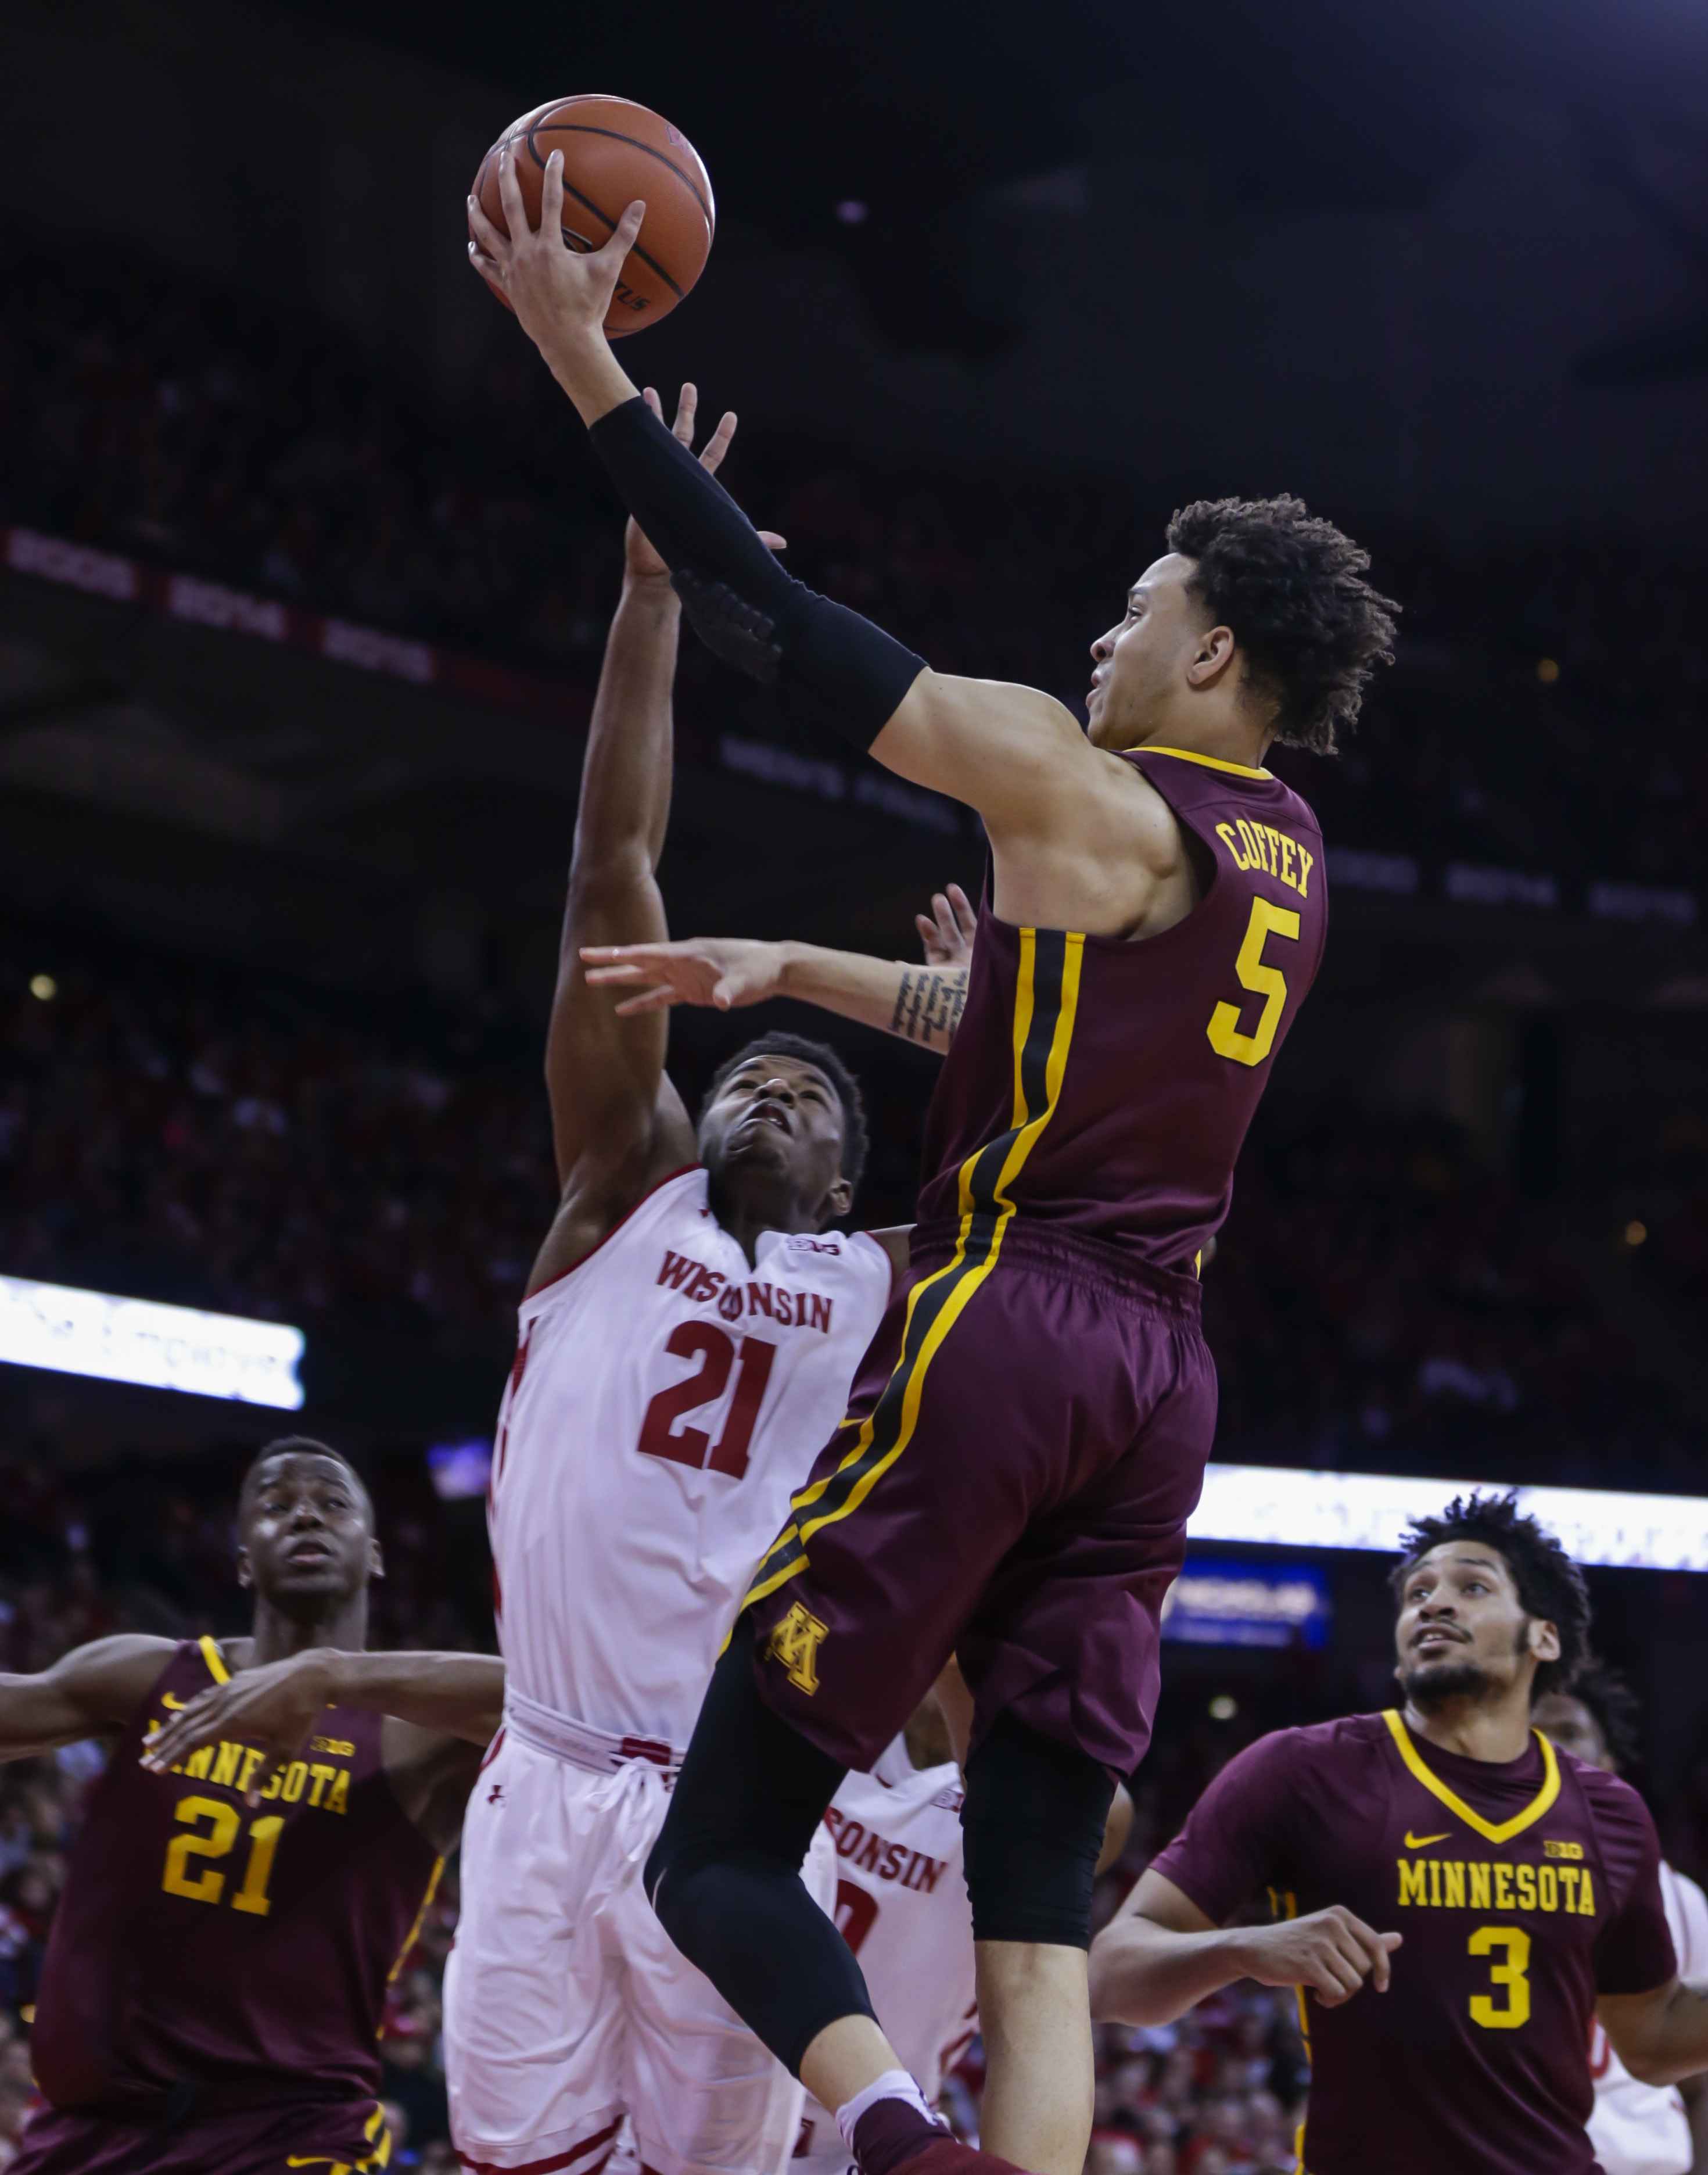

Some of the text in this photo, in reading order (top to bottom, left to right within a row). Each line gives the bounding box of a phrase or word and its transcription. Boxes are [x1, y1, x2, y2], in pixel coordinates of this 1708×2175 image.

[1215, 818, 1314, 899] COFFEY
[1205, 895, 1301, 1067] 5
[637, 1320, 777, 1481] 21
[148, 1718, 351, 1815] NNESOTA
[161, 1794, 286, 1916] 21
[1397, 1858, 1596, 1917] MINNESOTA
[1467, 1925, 1532, 2030] 3
